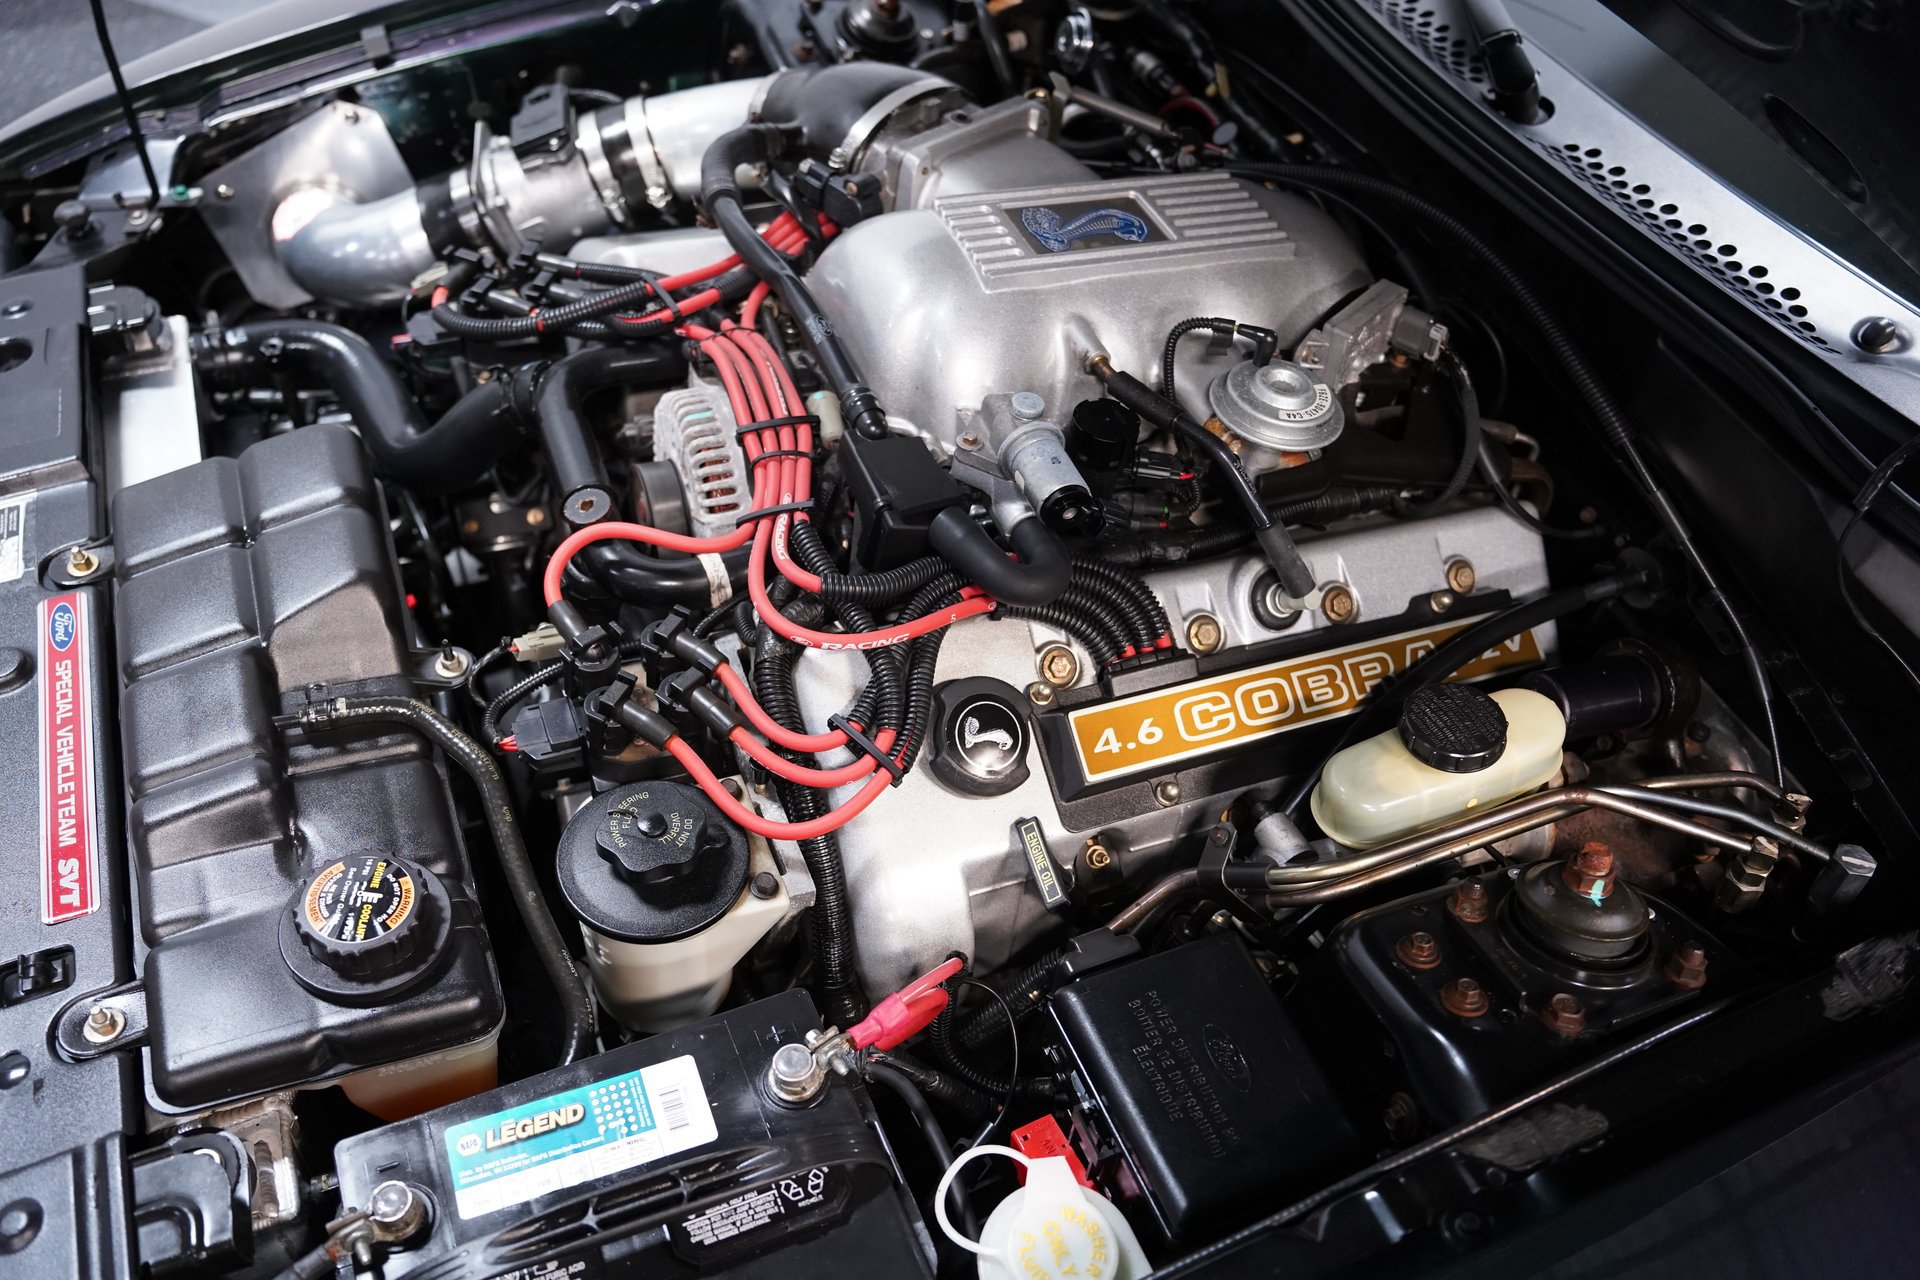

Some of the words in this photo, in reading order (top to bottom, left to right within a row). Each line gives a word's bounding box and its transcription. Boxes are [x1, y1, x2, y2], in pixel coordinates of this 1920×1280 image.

[775, 511, 790, 560] RACING
[54, 612, 73, 643] Ford
[821, 633, 910, 651] RACING
[55, 659, 73, 725] SPECIAL
[1093, 718, 1164, 754] 4.6
[56, 725, 75, 795] VEHICLE
[612, 791, 650, 818] SEERING
[622, 806, 638, 829] FLUD
[57, 794, 77, 848] TEAM
[610, 820, 627, 848] POWER
[659, 812, 681, 844] OVERFILL
[684, 818, 693, 830] DO
[675, 832, 690, 848] NOT
[347, 867, 357, 880] See
[370, 861, 387, 889] ENGINE
[1026, 832, 1048, 870] ENGINE
[1041, 871, 1055, 891] OIL
[57, 857, 80, 907] SVT
[339, 881, 352, 903] Owner
[386, 873, 396, 882] DO
[392, 883, 401, 896] NOT
[355, 904, 373, 939] COOLANT
[387, 896, 400, 916] OPEN
[390, 888, 412, 925] WARNING
[460, 1139, 478, 1151] NAPA
[485, 1103, 586, 1151] LEGEND
[1042, 1220, 1080, 1277] ONLY
[1060, 1205, 1107, 1278] WASHER
